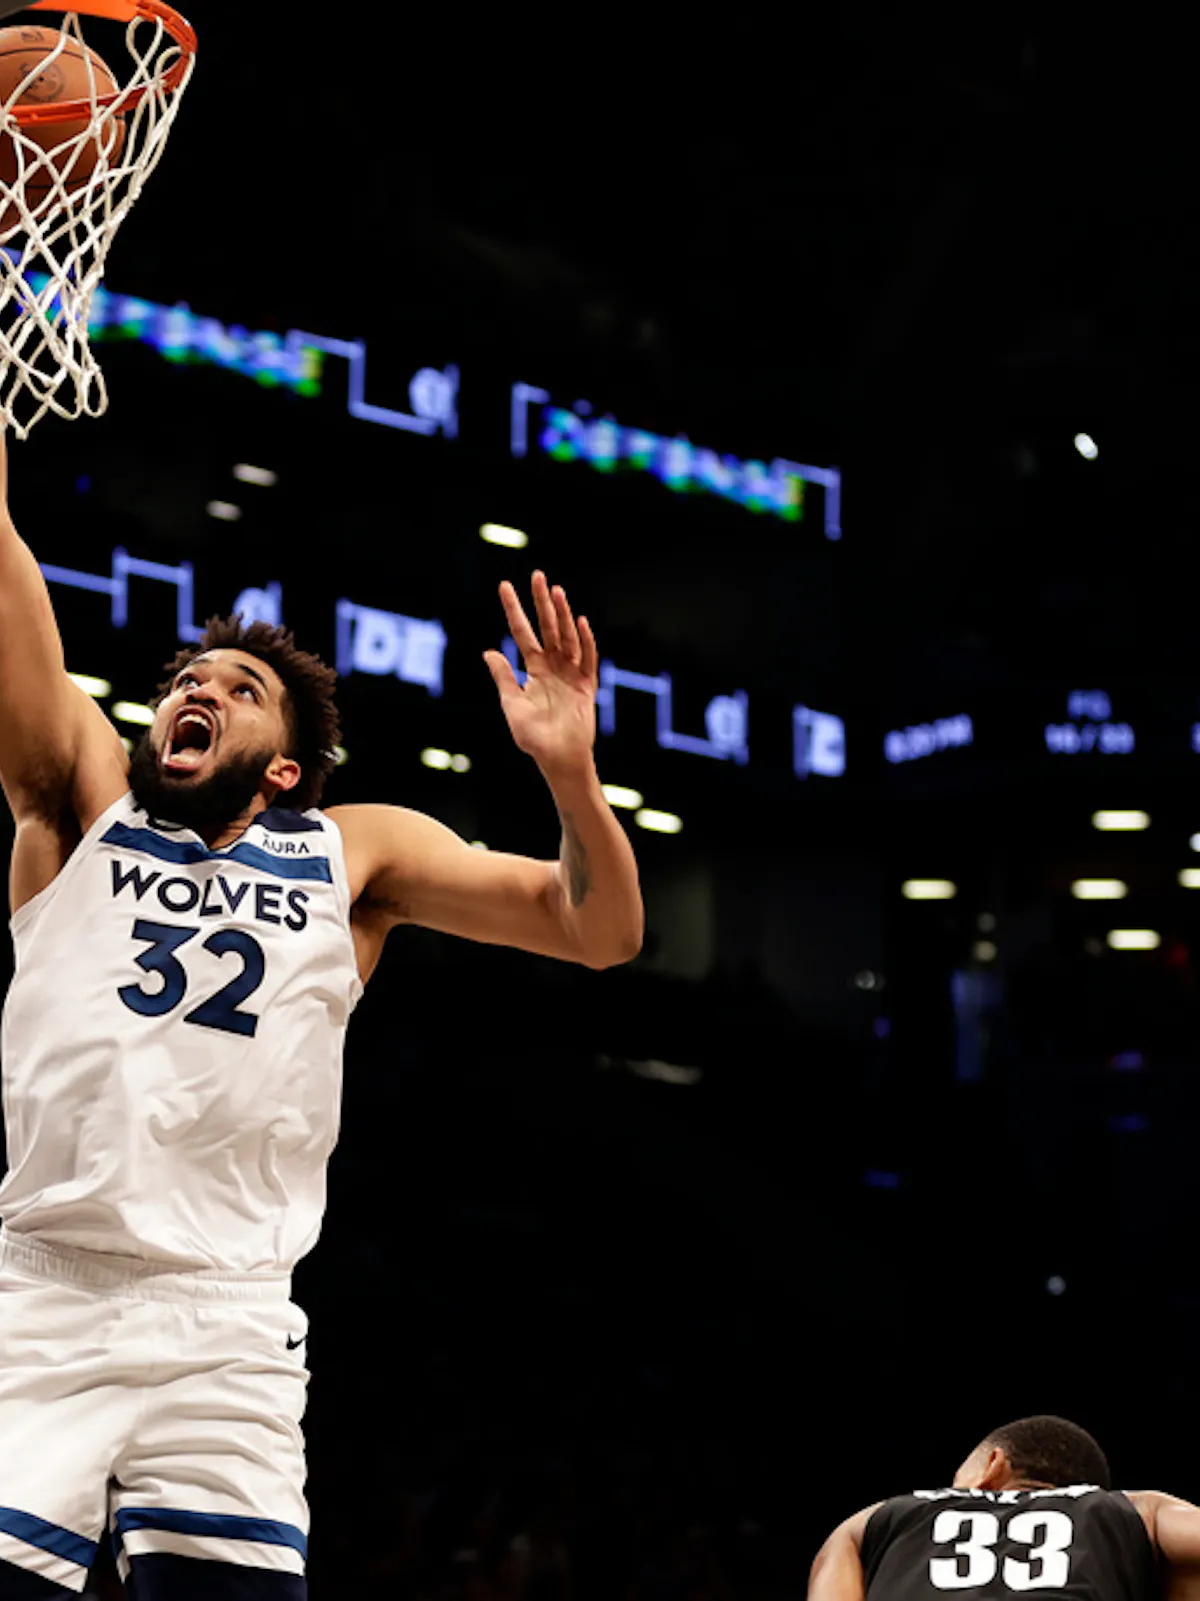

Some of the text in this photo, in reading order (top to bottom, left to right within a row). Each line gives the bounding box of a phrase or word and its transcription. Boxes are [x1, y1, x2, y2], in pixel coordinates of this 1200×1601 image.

[111, 859, 310, 932] WOLVES
[117, 918, 266, 1039] 32
[928, 1509, 1075, 1592] 33
